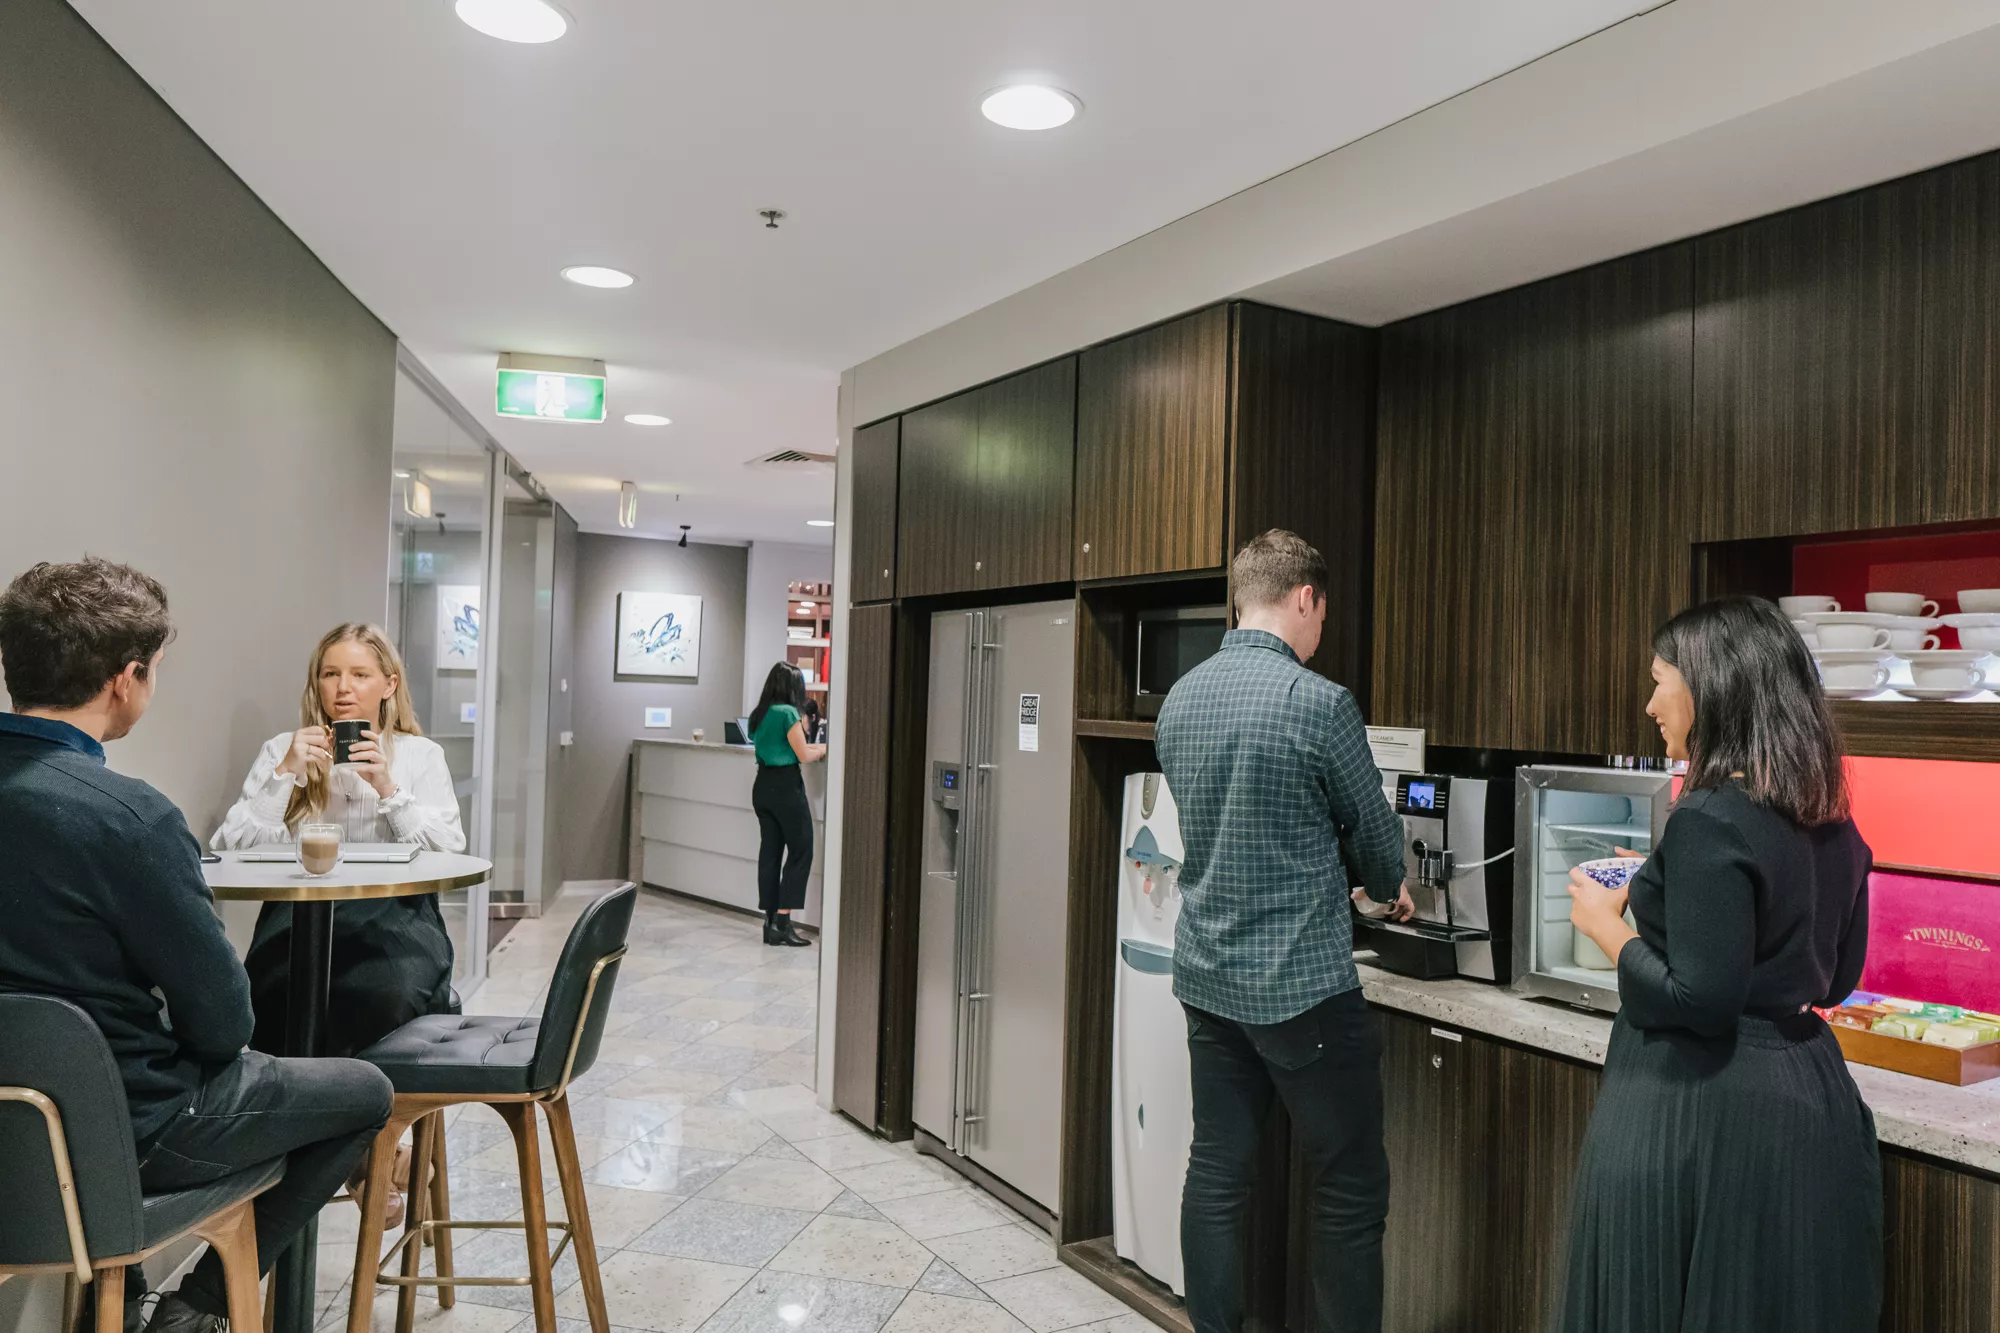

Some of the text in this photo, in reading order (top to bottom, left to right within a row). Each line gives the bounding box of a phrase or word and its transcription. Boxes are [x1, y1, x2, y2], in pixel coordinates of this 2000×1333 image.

[1022, 698, 1038, 707] GREAT
[1021, 707, 1037, 716] FRIDGE
[1910, 927, 1983, 950] TWININGS
